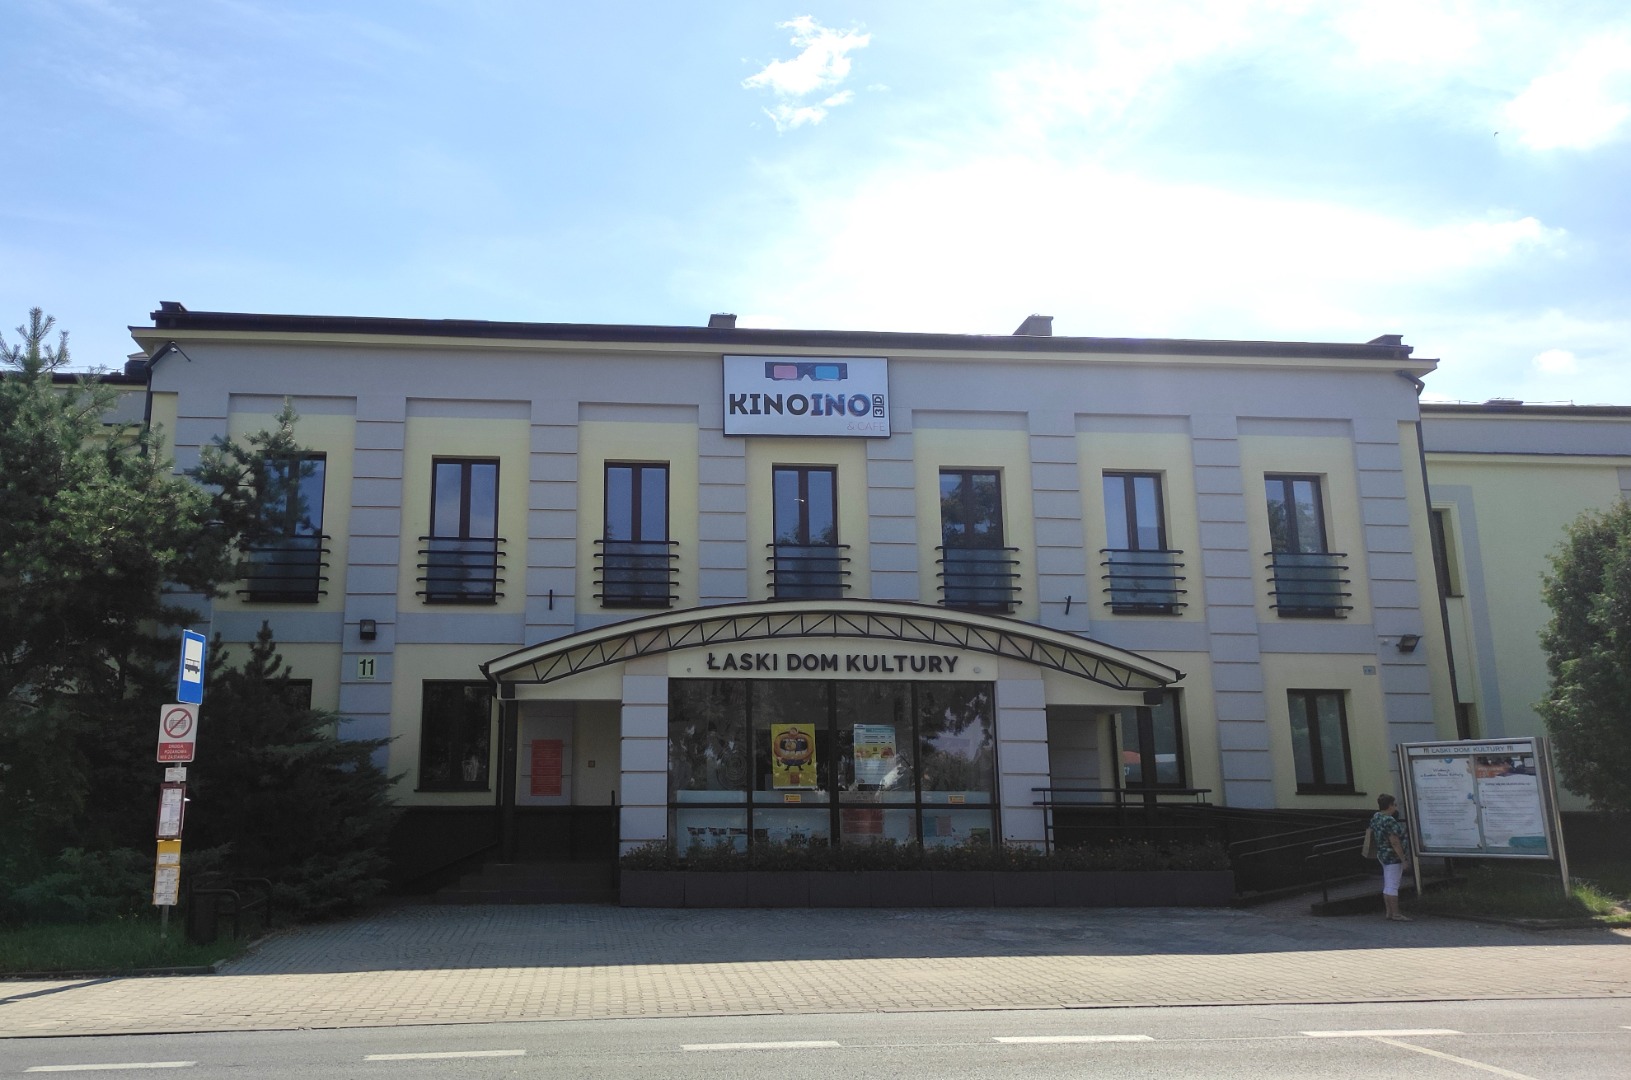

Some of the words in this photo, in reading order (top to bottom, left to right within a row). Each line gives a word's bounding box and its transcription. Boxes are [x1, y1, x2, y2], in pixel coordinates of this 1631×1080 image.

[360, 659, 374, 675] 11
[707, 652, 778, 671] ŁASKI
[786, 653, 838, 672] DOM
[846, 654, 959, 673] KULTURY
[1472, 745, 1505, 753] KULTURY
